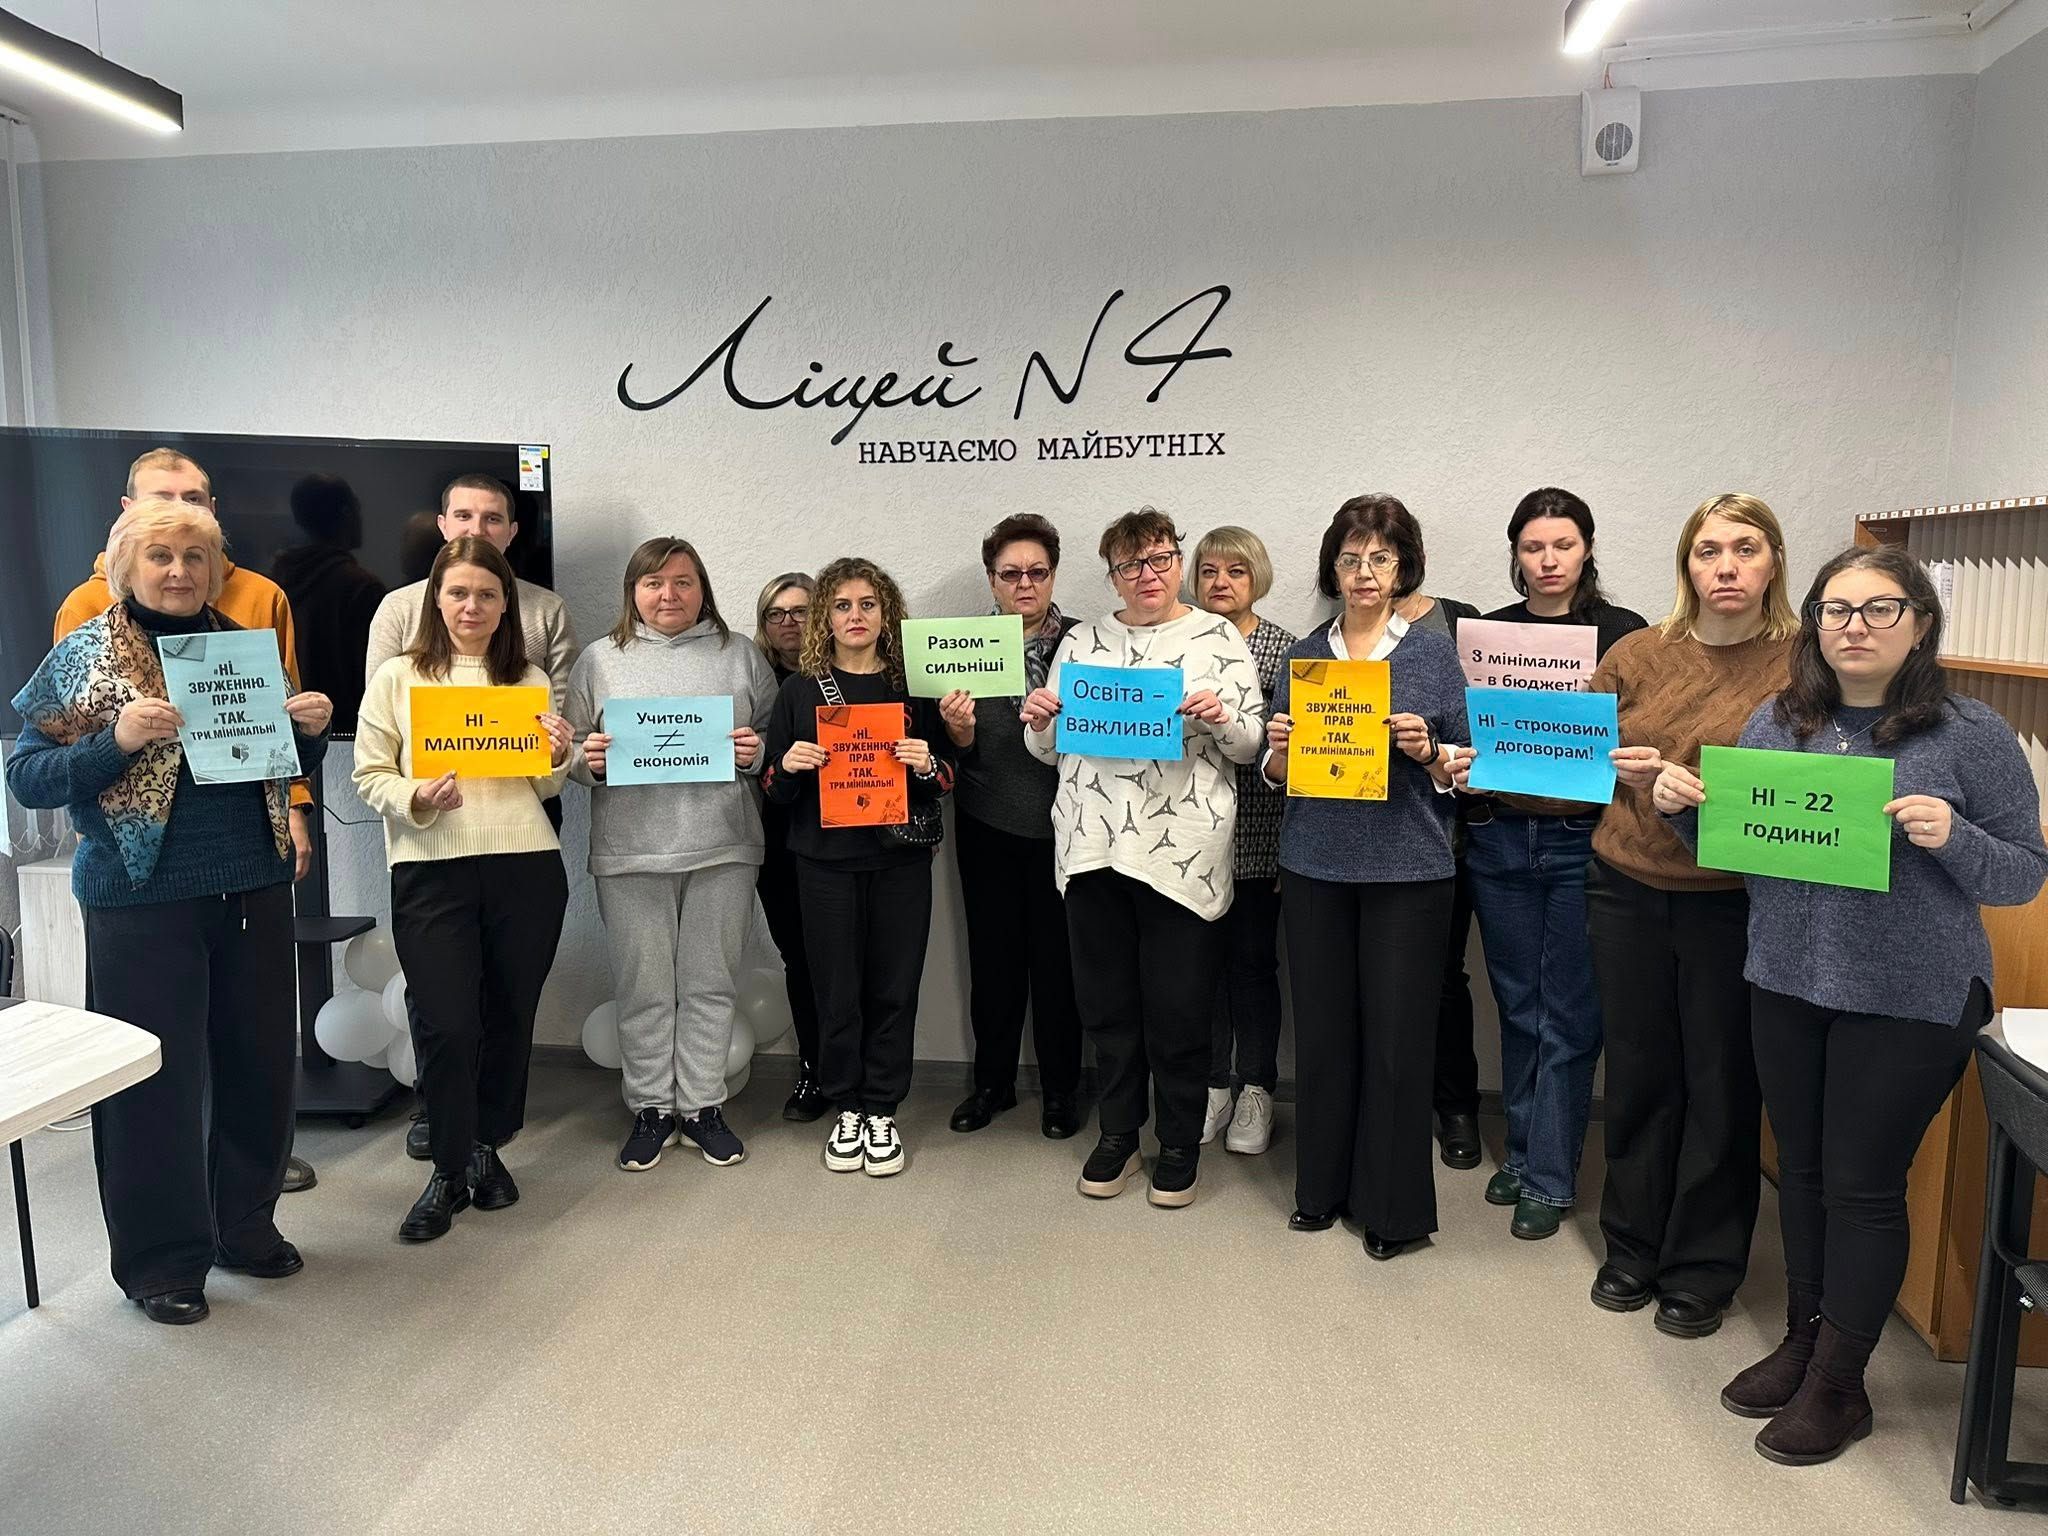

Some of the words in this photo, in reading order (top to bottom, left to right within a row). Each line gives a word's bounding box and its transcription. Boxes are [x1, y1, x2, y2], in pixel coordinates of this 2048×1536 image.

[617, 295, 982, 445] Ліцей
[857, 439, 1018, 465] НАВЧАЄМО
[1037, 430, 1226, 460] МАЙБУТНІХ
[927, 636, 984, 650] Разом
[925, 658, 1004, 674] сильніші
[1488, 652, 1581, 670] мінімалки
[819, 678, 842, 704] LOV
[1073, 679, 1143, 703] Освіта
[1488, 677, 1497, 686] в
[1502, 674, 1578, 692] бюджет!
[211, 692, 247, 706] ПРАВ
[465, 713, 484, 727] НІ
[636, 711, 703, 726] Учитель
[1066, 716, 1172, 737] важлива!
[1324, 715, 1354, 726] ПРАВ
[1478, 714, 1495, 729] НІ
[1514, 719, 1609, 737] строковим
[424, 735, 540, 753] МАІПУЛЯЦІЇ!
[1494, 739, 1595, 760] договорам!
[633, 752, 709, 769] економія
[849, 753, 875, 762] ПРАВ
[1751, 787, 1775, 807] НІ
[1804, 792, 1834, 813] 22
[1743, 822, 1840, 847] години!
